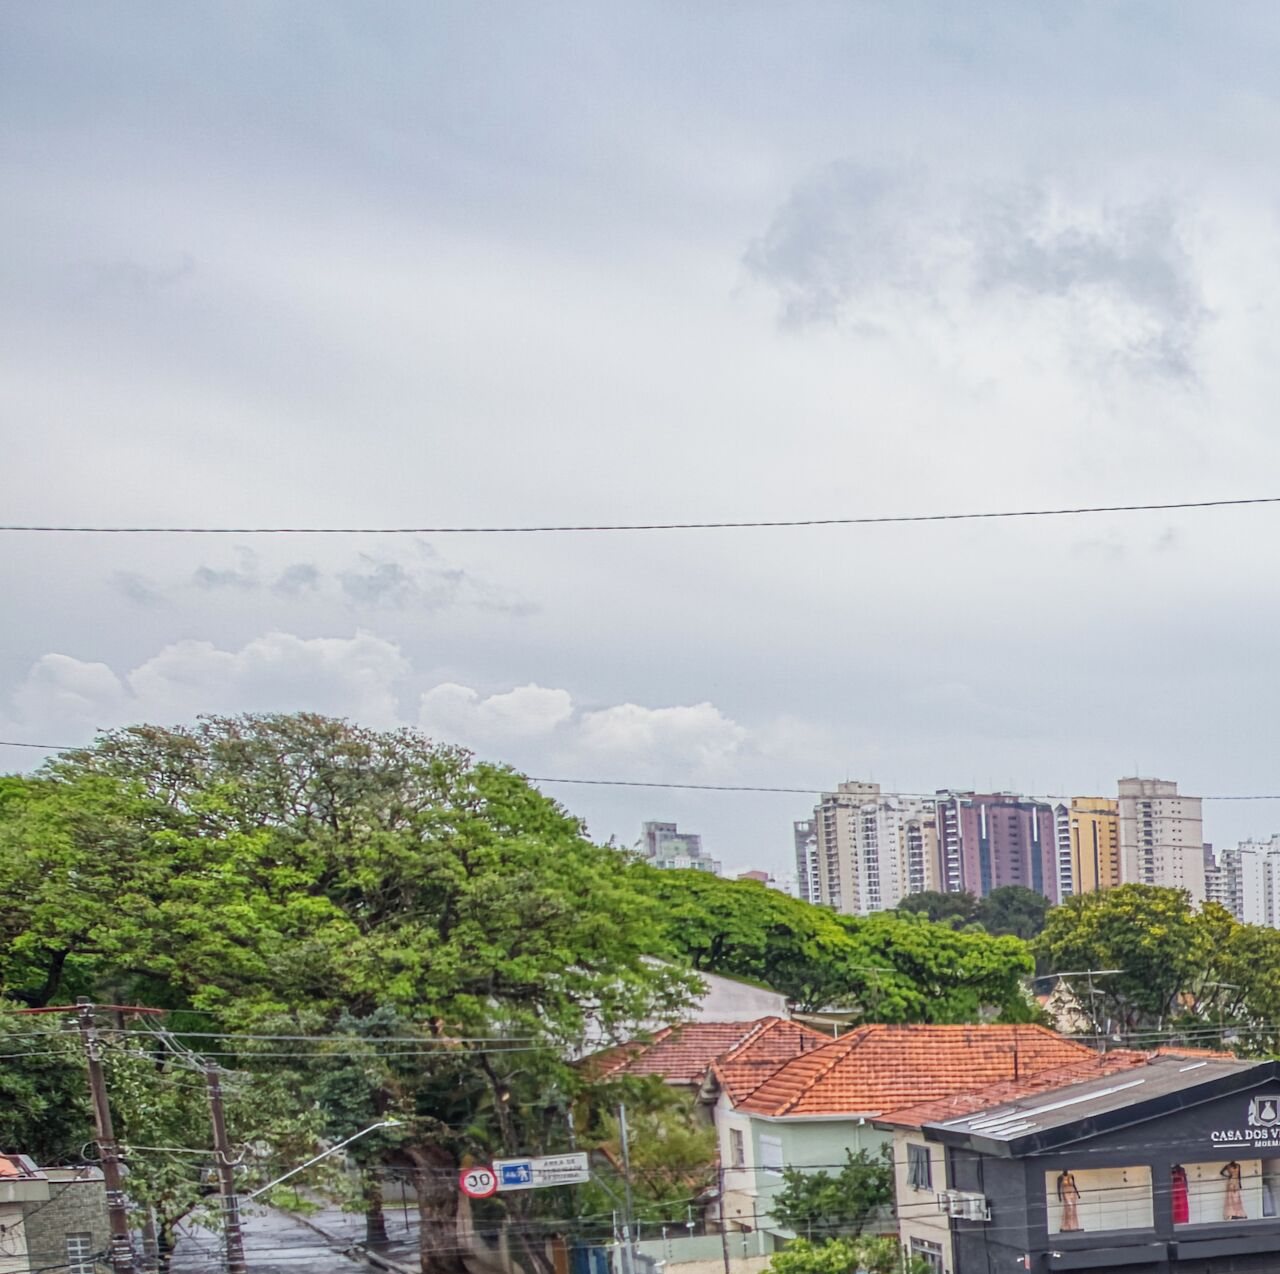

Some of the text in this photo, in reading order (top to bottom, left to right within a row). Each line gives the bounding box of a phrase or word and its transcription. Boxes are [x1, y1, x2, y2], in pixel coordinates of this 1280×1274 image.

[1211, 1129, 1243, 1141] CASA
[1245, 1127, 1268, 1140] DOS
[468, 1173, 490, 1188] 30
